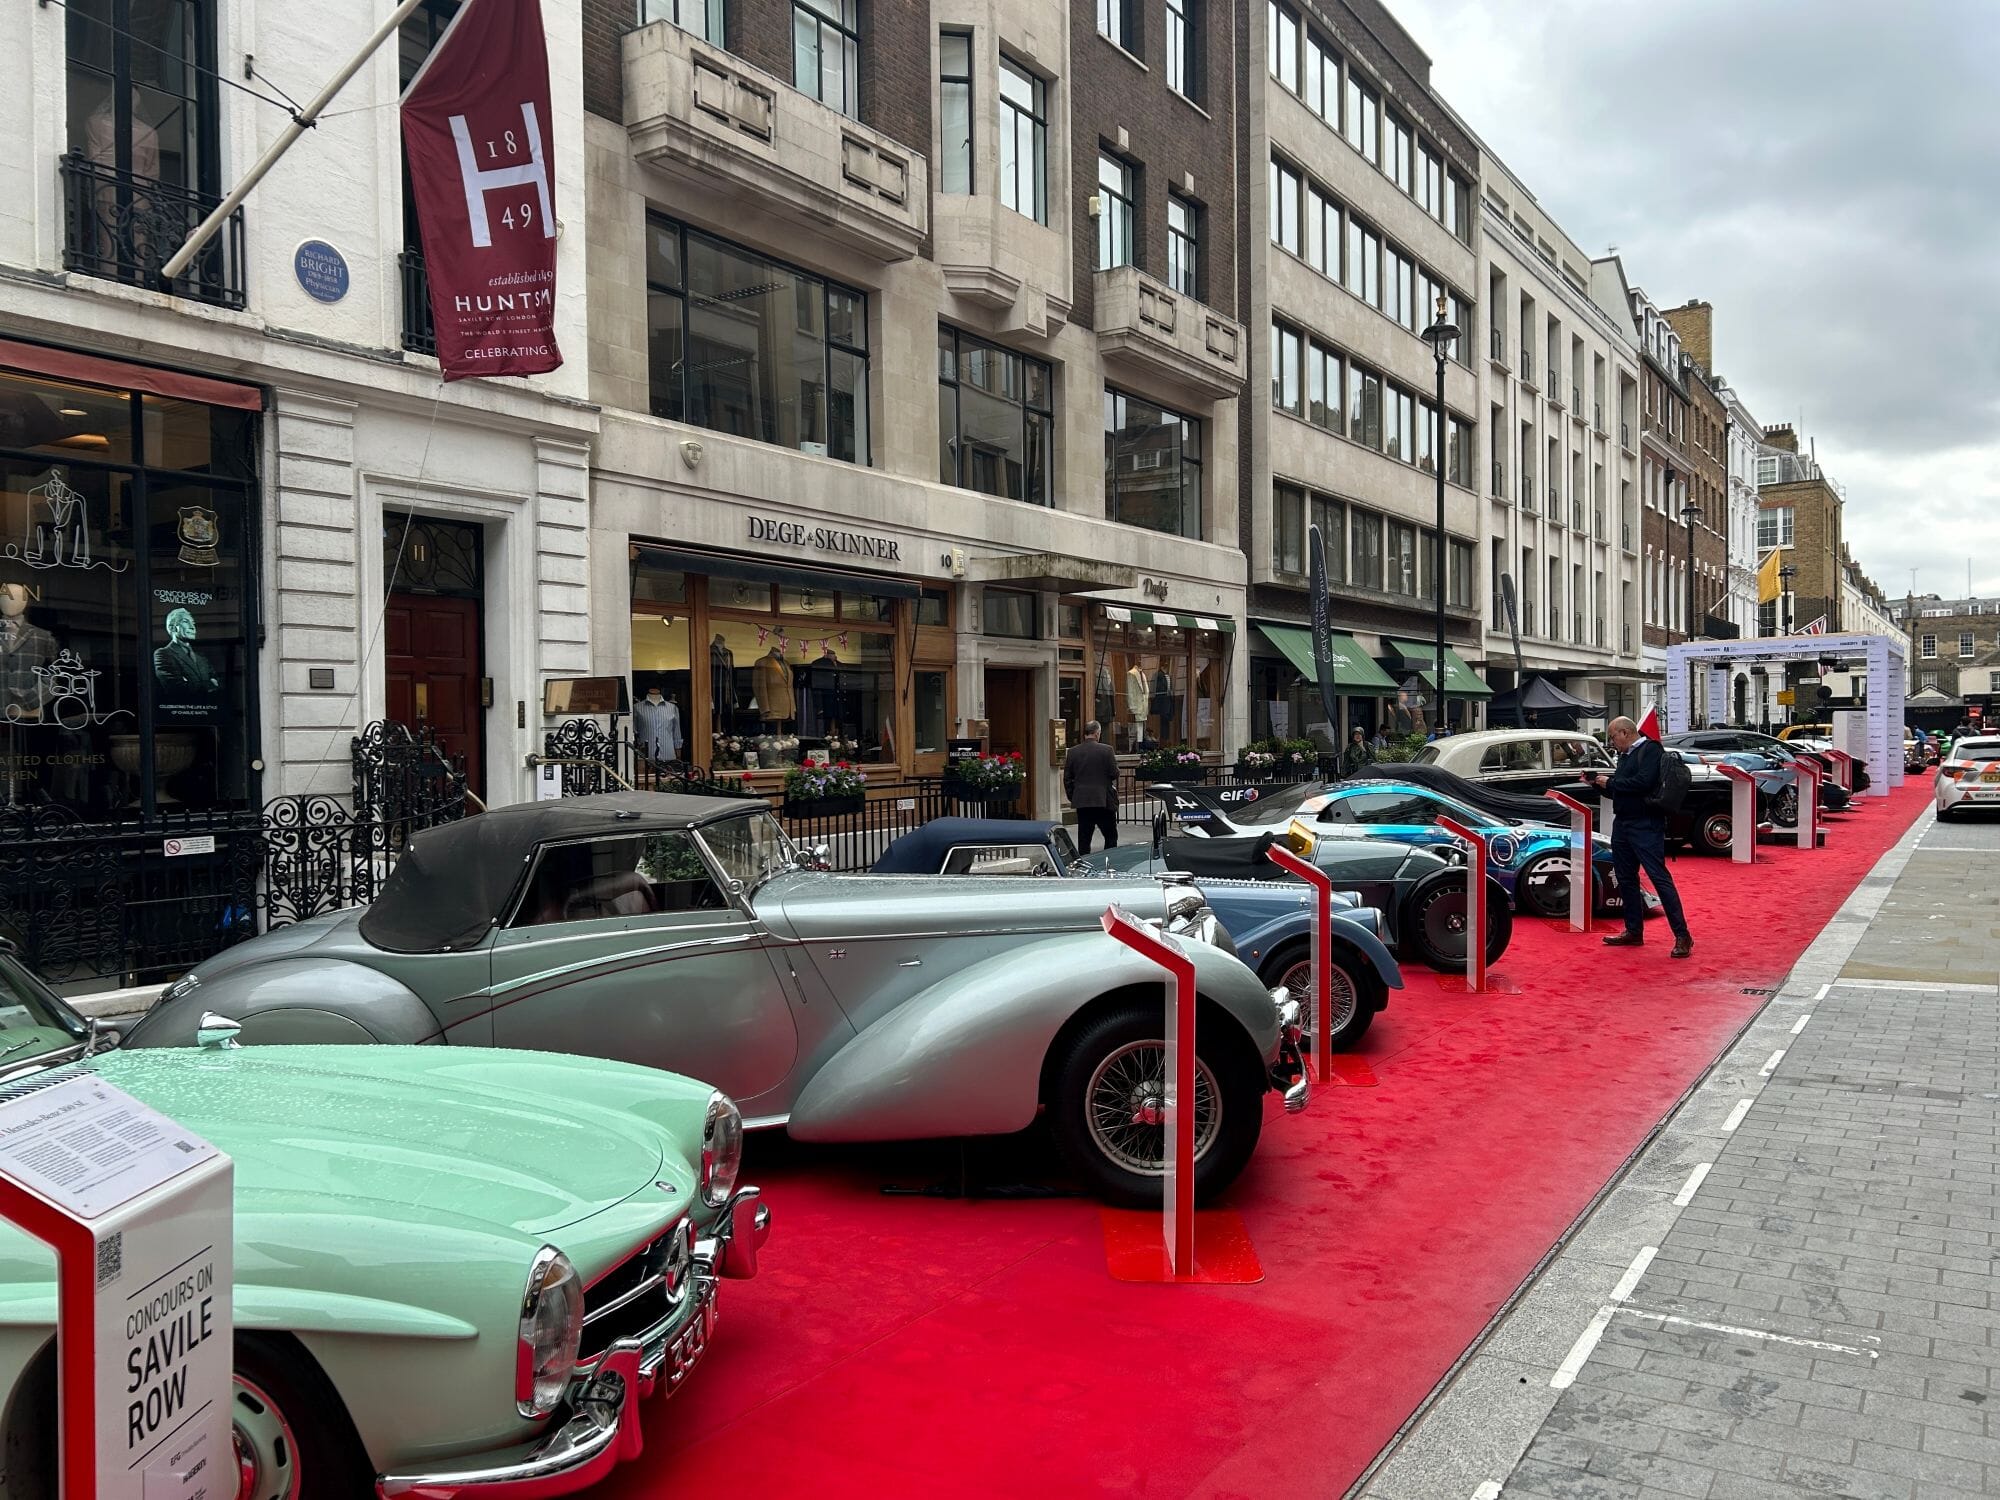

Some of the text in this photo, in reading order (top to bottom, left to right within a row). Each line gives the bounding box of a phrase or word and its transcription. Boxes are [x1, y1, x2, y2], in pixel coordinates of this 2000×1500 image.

[304, 250, 340, 266] RICHARD
[300, 256, 344, 278] BRIGHT
[488, 270, 537, 286] established
[464, 345, 548, 359] CELEBRATING
[748, 516, 902, 562] DEGE & SKINNER
[941, 554, 951, 568] 10
[153, 589, 213, 601] CONCOURS ON
[159, 596, 208, 606] SAVILE ROW
[46, 754, 105, 766] CLOTHES
[1220, 789, 1244, 801] elf
[126, 1262, 213, 1341] CONCOURS ON
[126, 1295, 213, 1394] SAVILE
[128, 1364, 188, 1450] ROW
